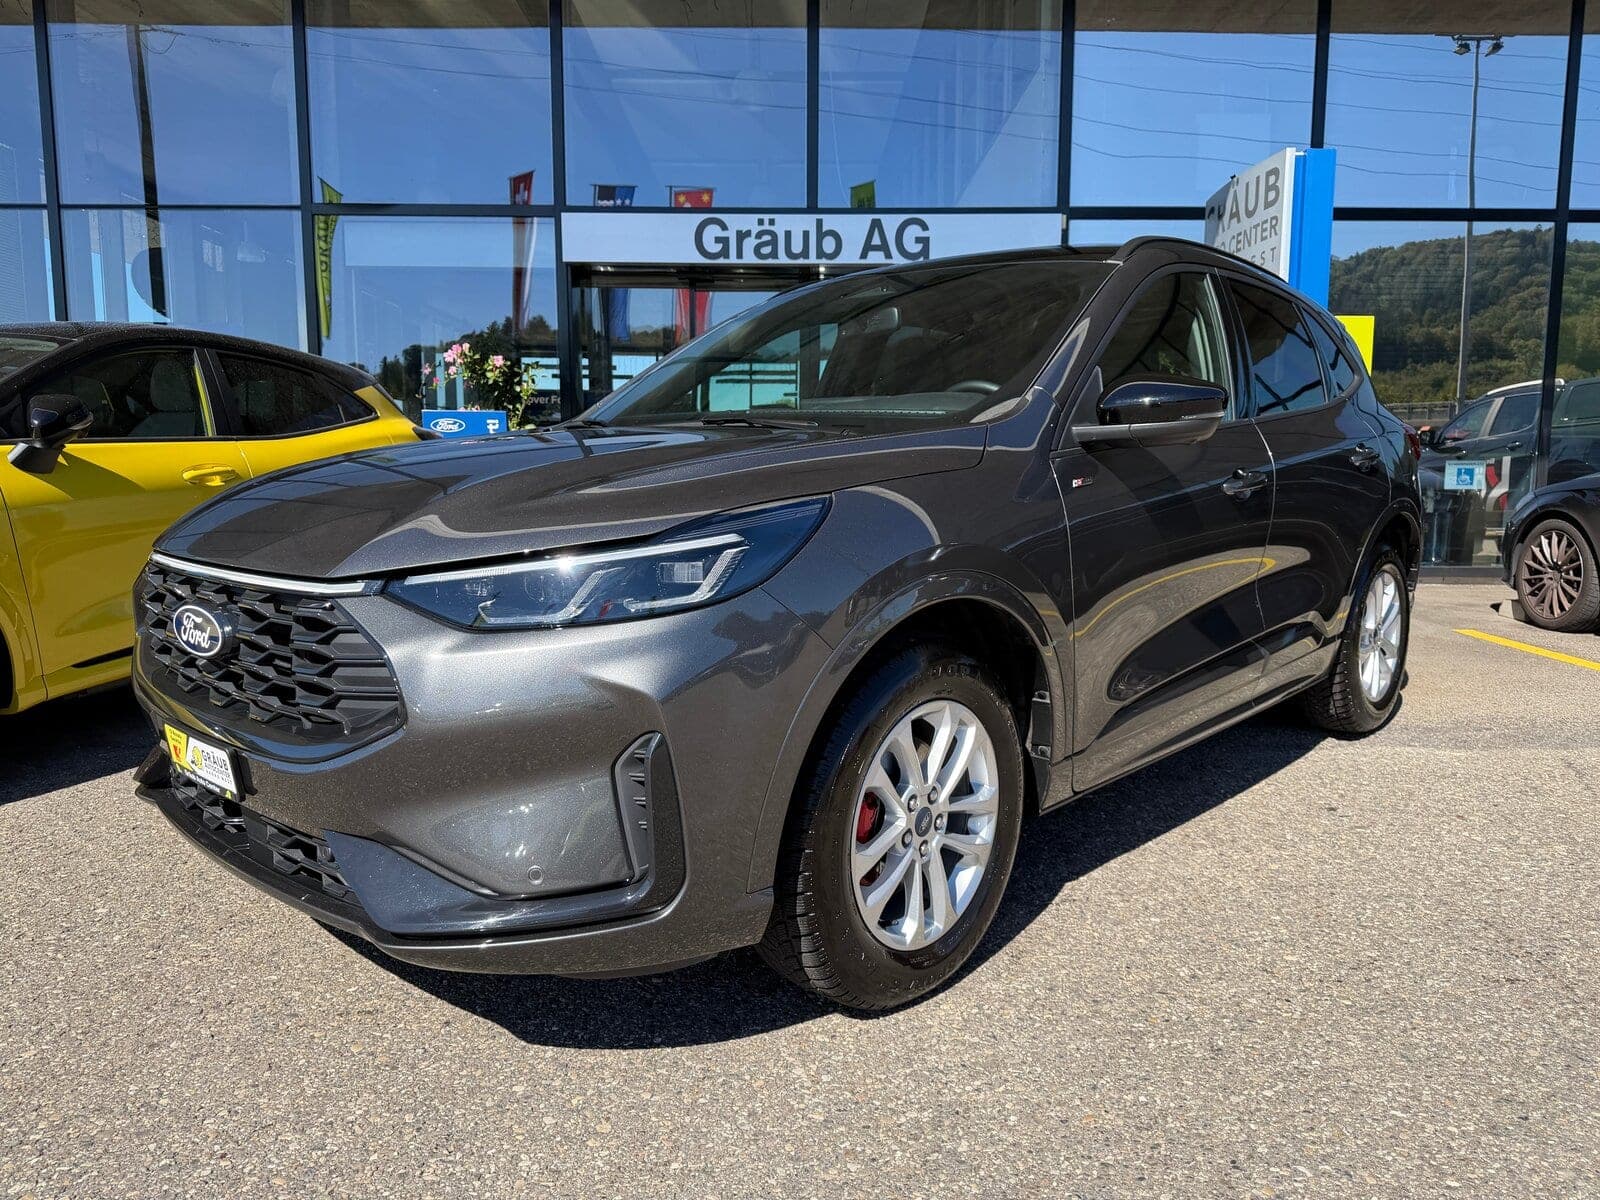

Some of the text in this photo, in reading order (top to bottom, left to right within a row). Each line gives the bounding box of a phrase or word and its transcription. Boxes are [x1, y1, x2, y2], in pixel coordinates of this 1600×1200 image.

[694, 217, 931, 262] Gräub AG
[436, 418, 460, 431] Ford
[181, 612, 211, 649] Ford
